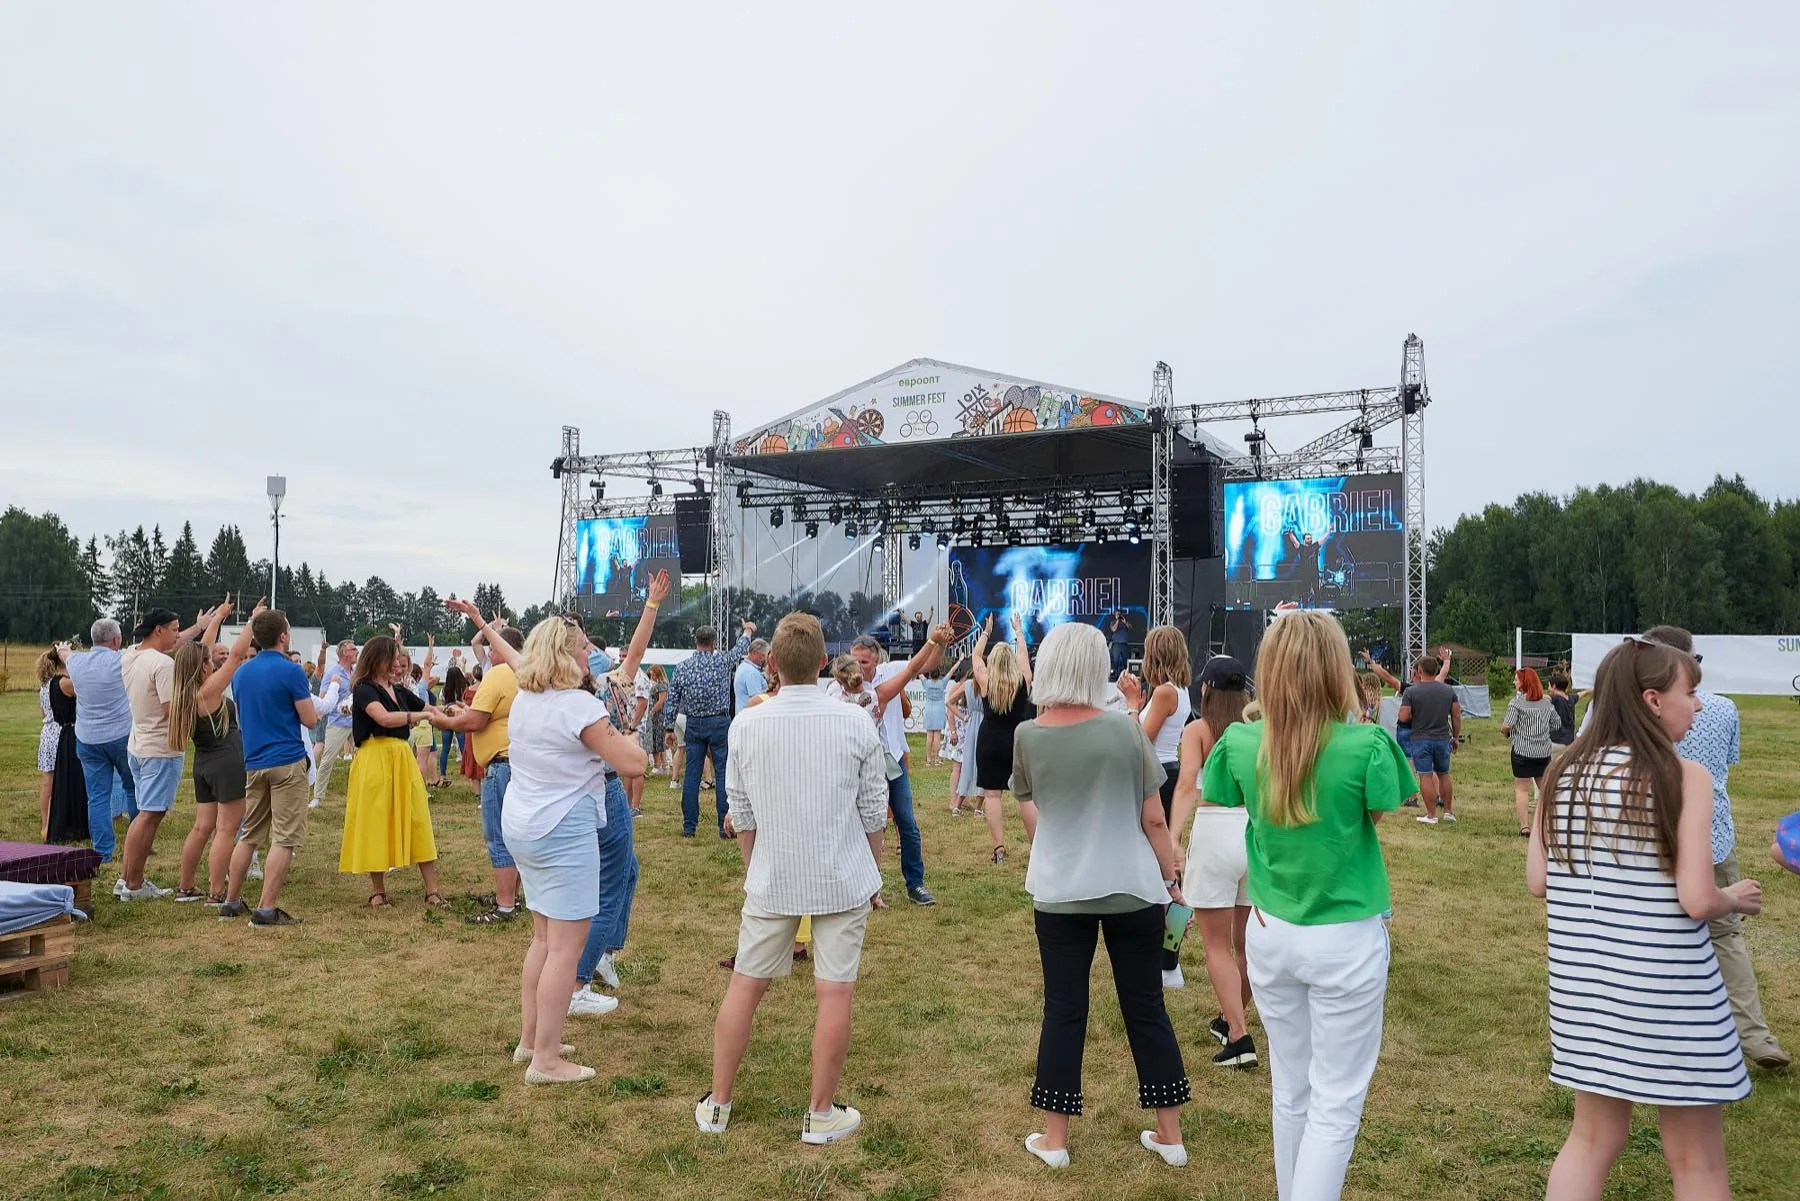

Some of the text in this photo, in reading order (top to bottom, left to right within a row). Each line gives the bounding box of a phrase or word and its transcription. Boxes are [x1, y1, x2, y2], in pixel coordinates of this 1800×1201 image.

[892, 392, 946, 408] SUMMER FEST
[1260, 489, 1403, 537] GABRIEL
[1011, 577, 1128, 616] GABRIEL
